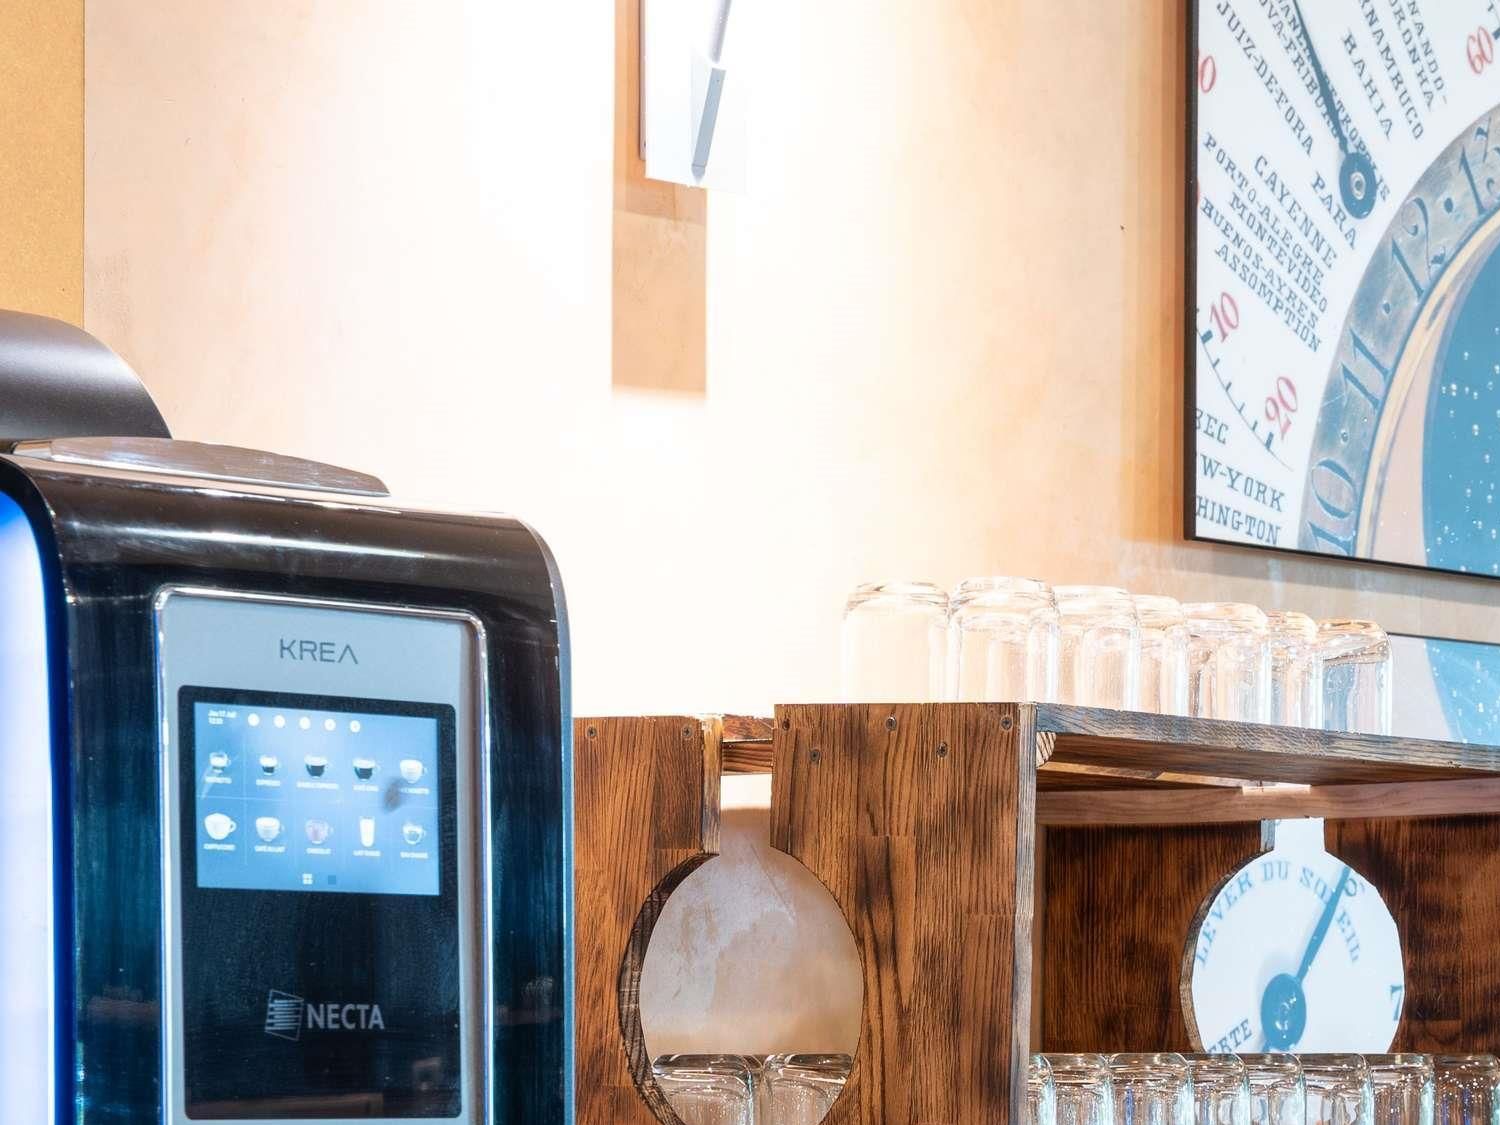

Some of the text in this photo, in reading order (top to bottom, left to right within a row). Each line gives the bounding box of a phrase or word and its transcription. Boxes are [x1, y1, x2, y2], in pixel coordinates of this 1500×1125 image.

[1342, 29, 1393, 139] BAHIA
[1200, 196, 1320, 331] BUENOS-AYRES
[1202, 132, 1325, 287] PORTO-ALEGRE
[1229, 191, 1329, 314] MONTEVIDEO
[1253, 154, 1338, 269] CAYENNE
[1311, 172, 1358, 250] PARA
[1208, 290, 1240, 344] 10
[1215, 242, 1323, 353] ASSOMPTION
[280, 638, 359, 665] KREA
[1195, 860, 1361, 969] LEVER DU SOEIL
[307, 1003, 384, 1030] NECTA
[1389, 984, 1403, 1022] 7
